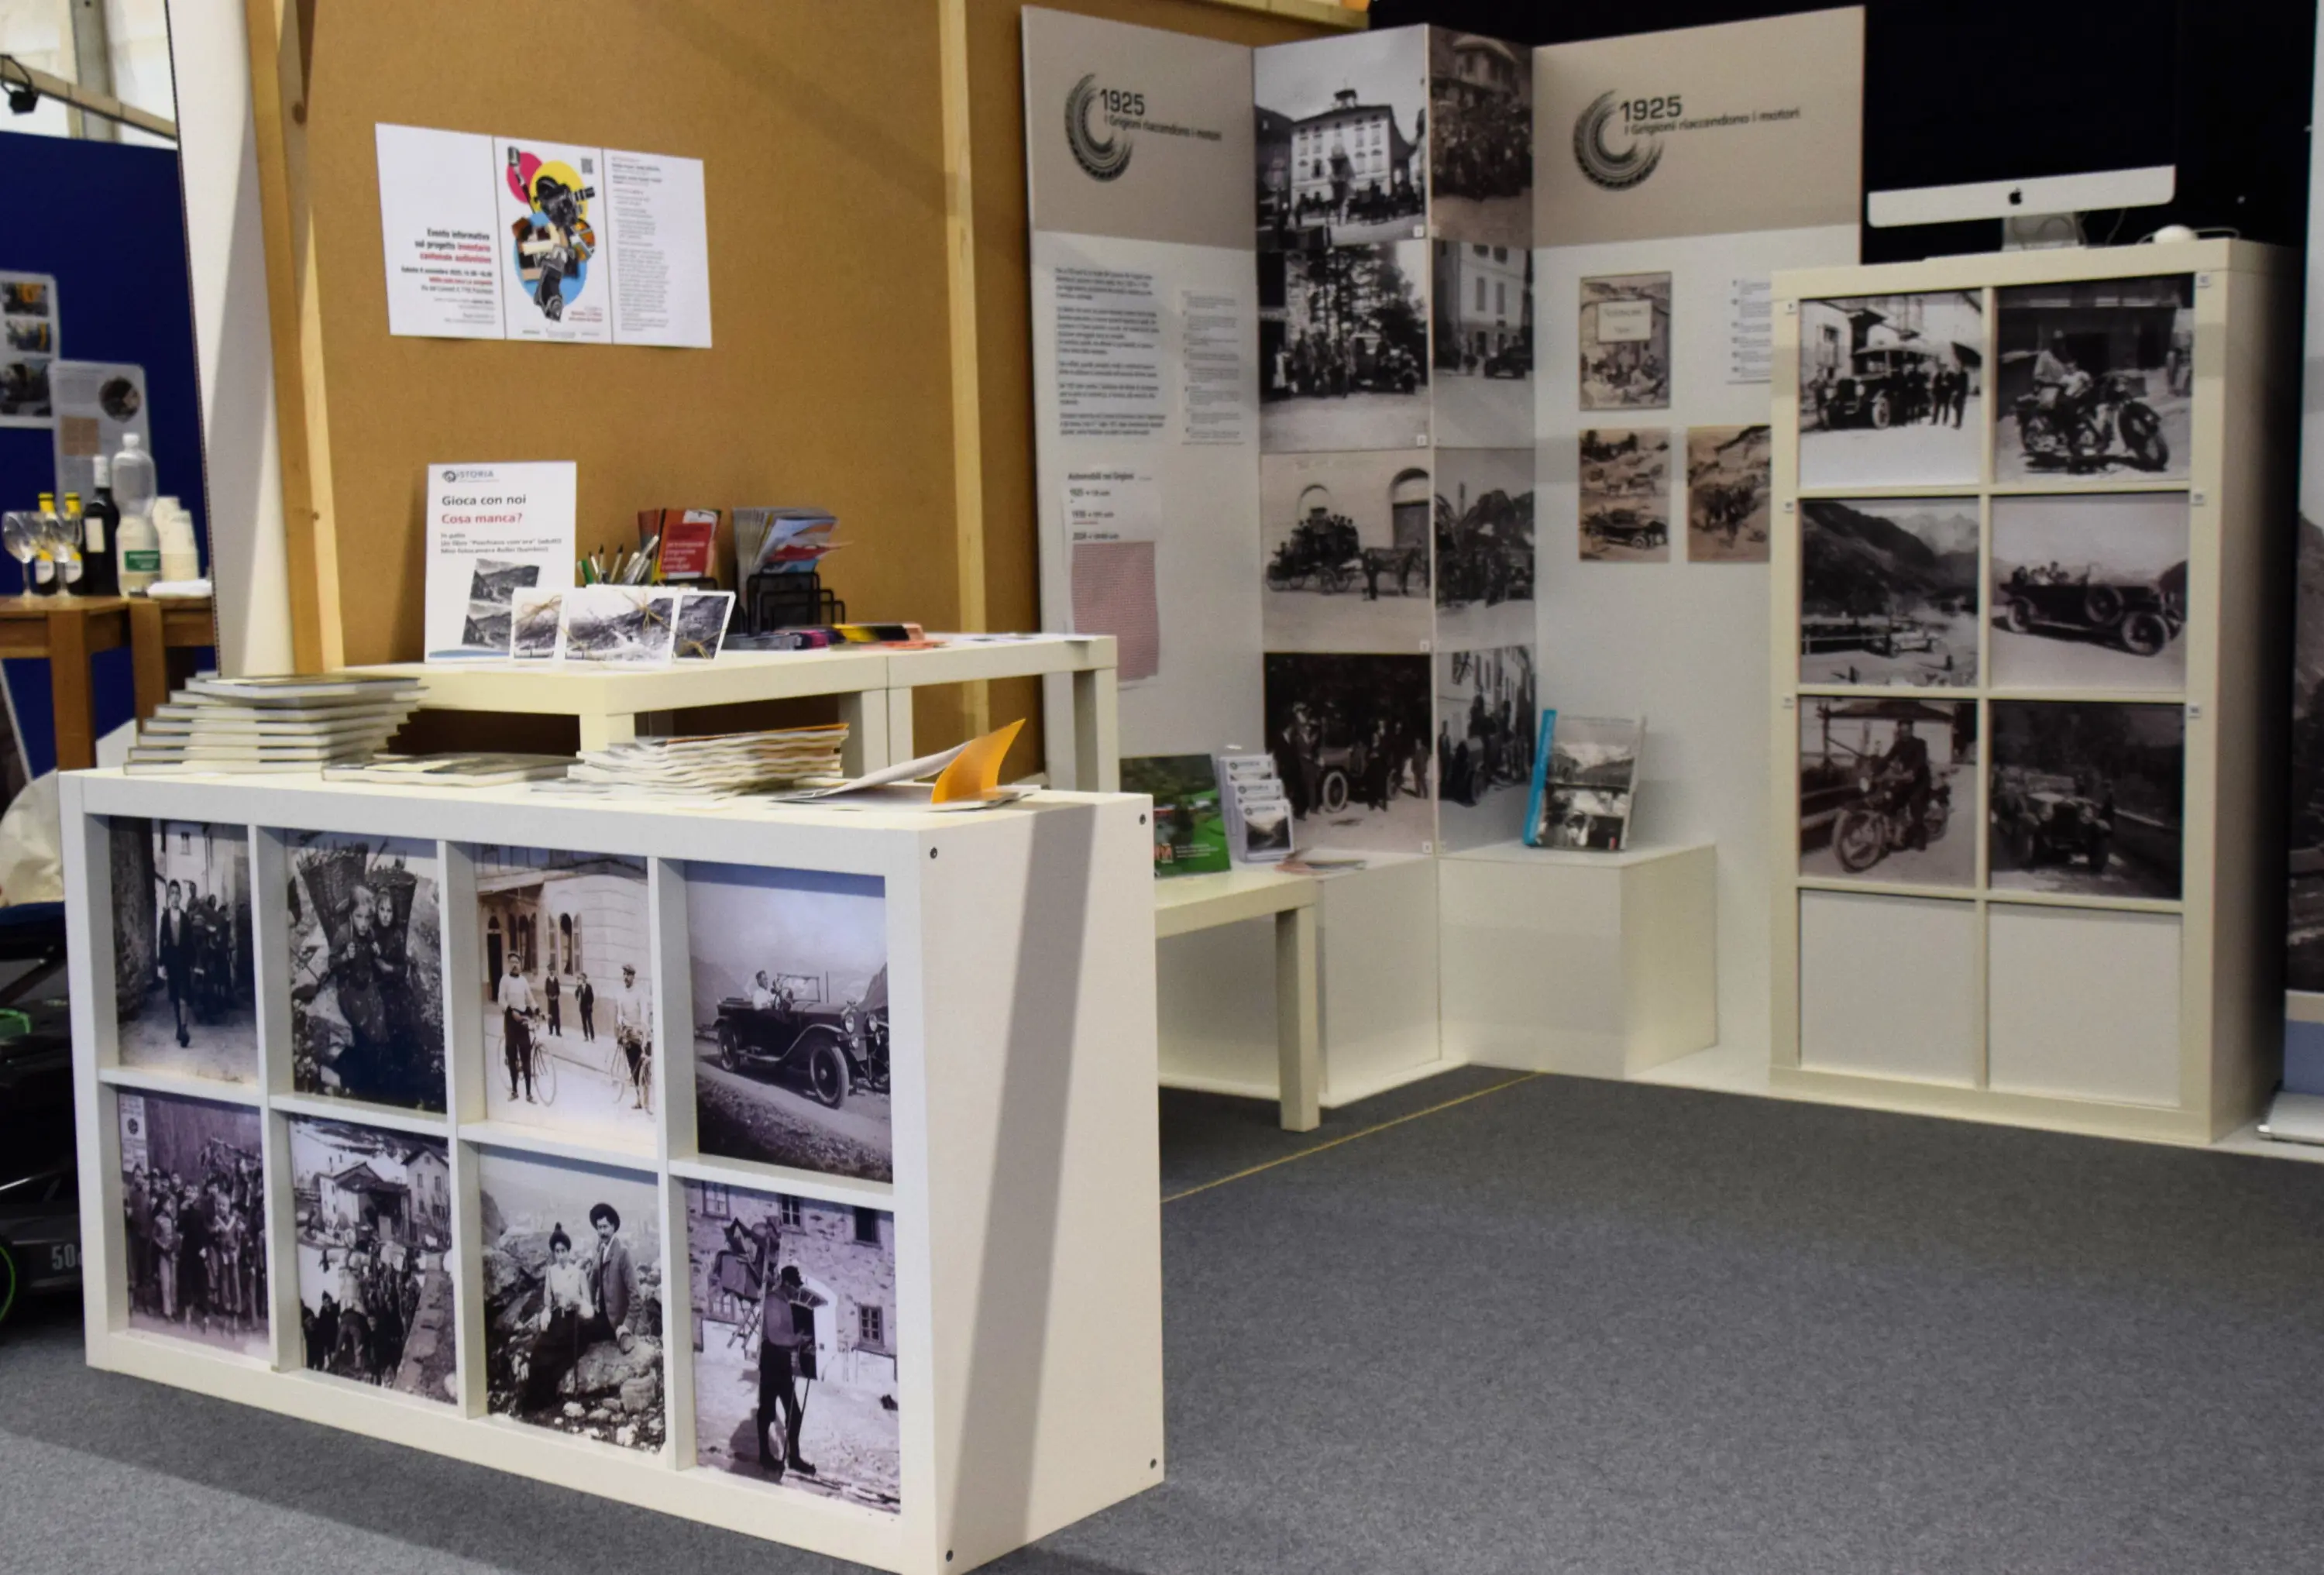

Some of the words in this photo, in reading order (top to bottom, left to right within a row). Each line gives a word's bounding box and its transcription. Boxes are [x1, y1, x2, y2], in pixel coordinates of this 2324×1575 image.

[1100, 88, 1145, 115] 1925
[1620, 95, 1682, 122] 1925
[442, 496, 476, 506] Gioca
[480, 496, 503, 505] con
[507, 494, 527, 504] noi
[442, 514, 471, 524] Cosa
[475, 513, 523, 524] manca?
